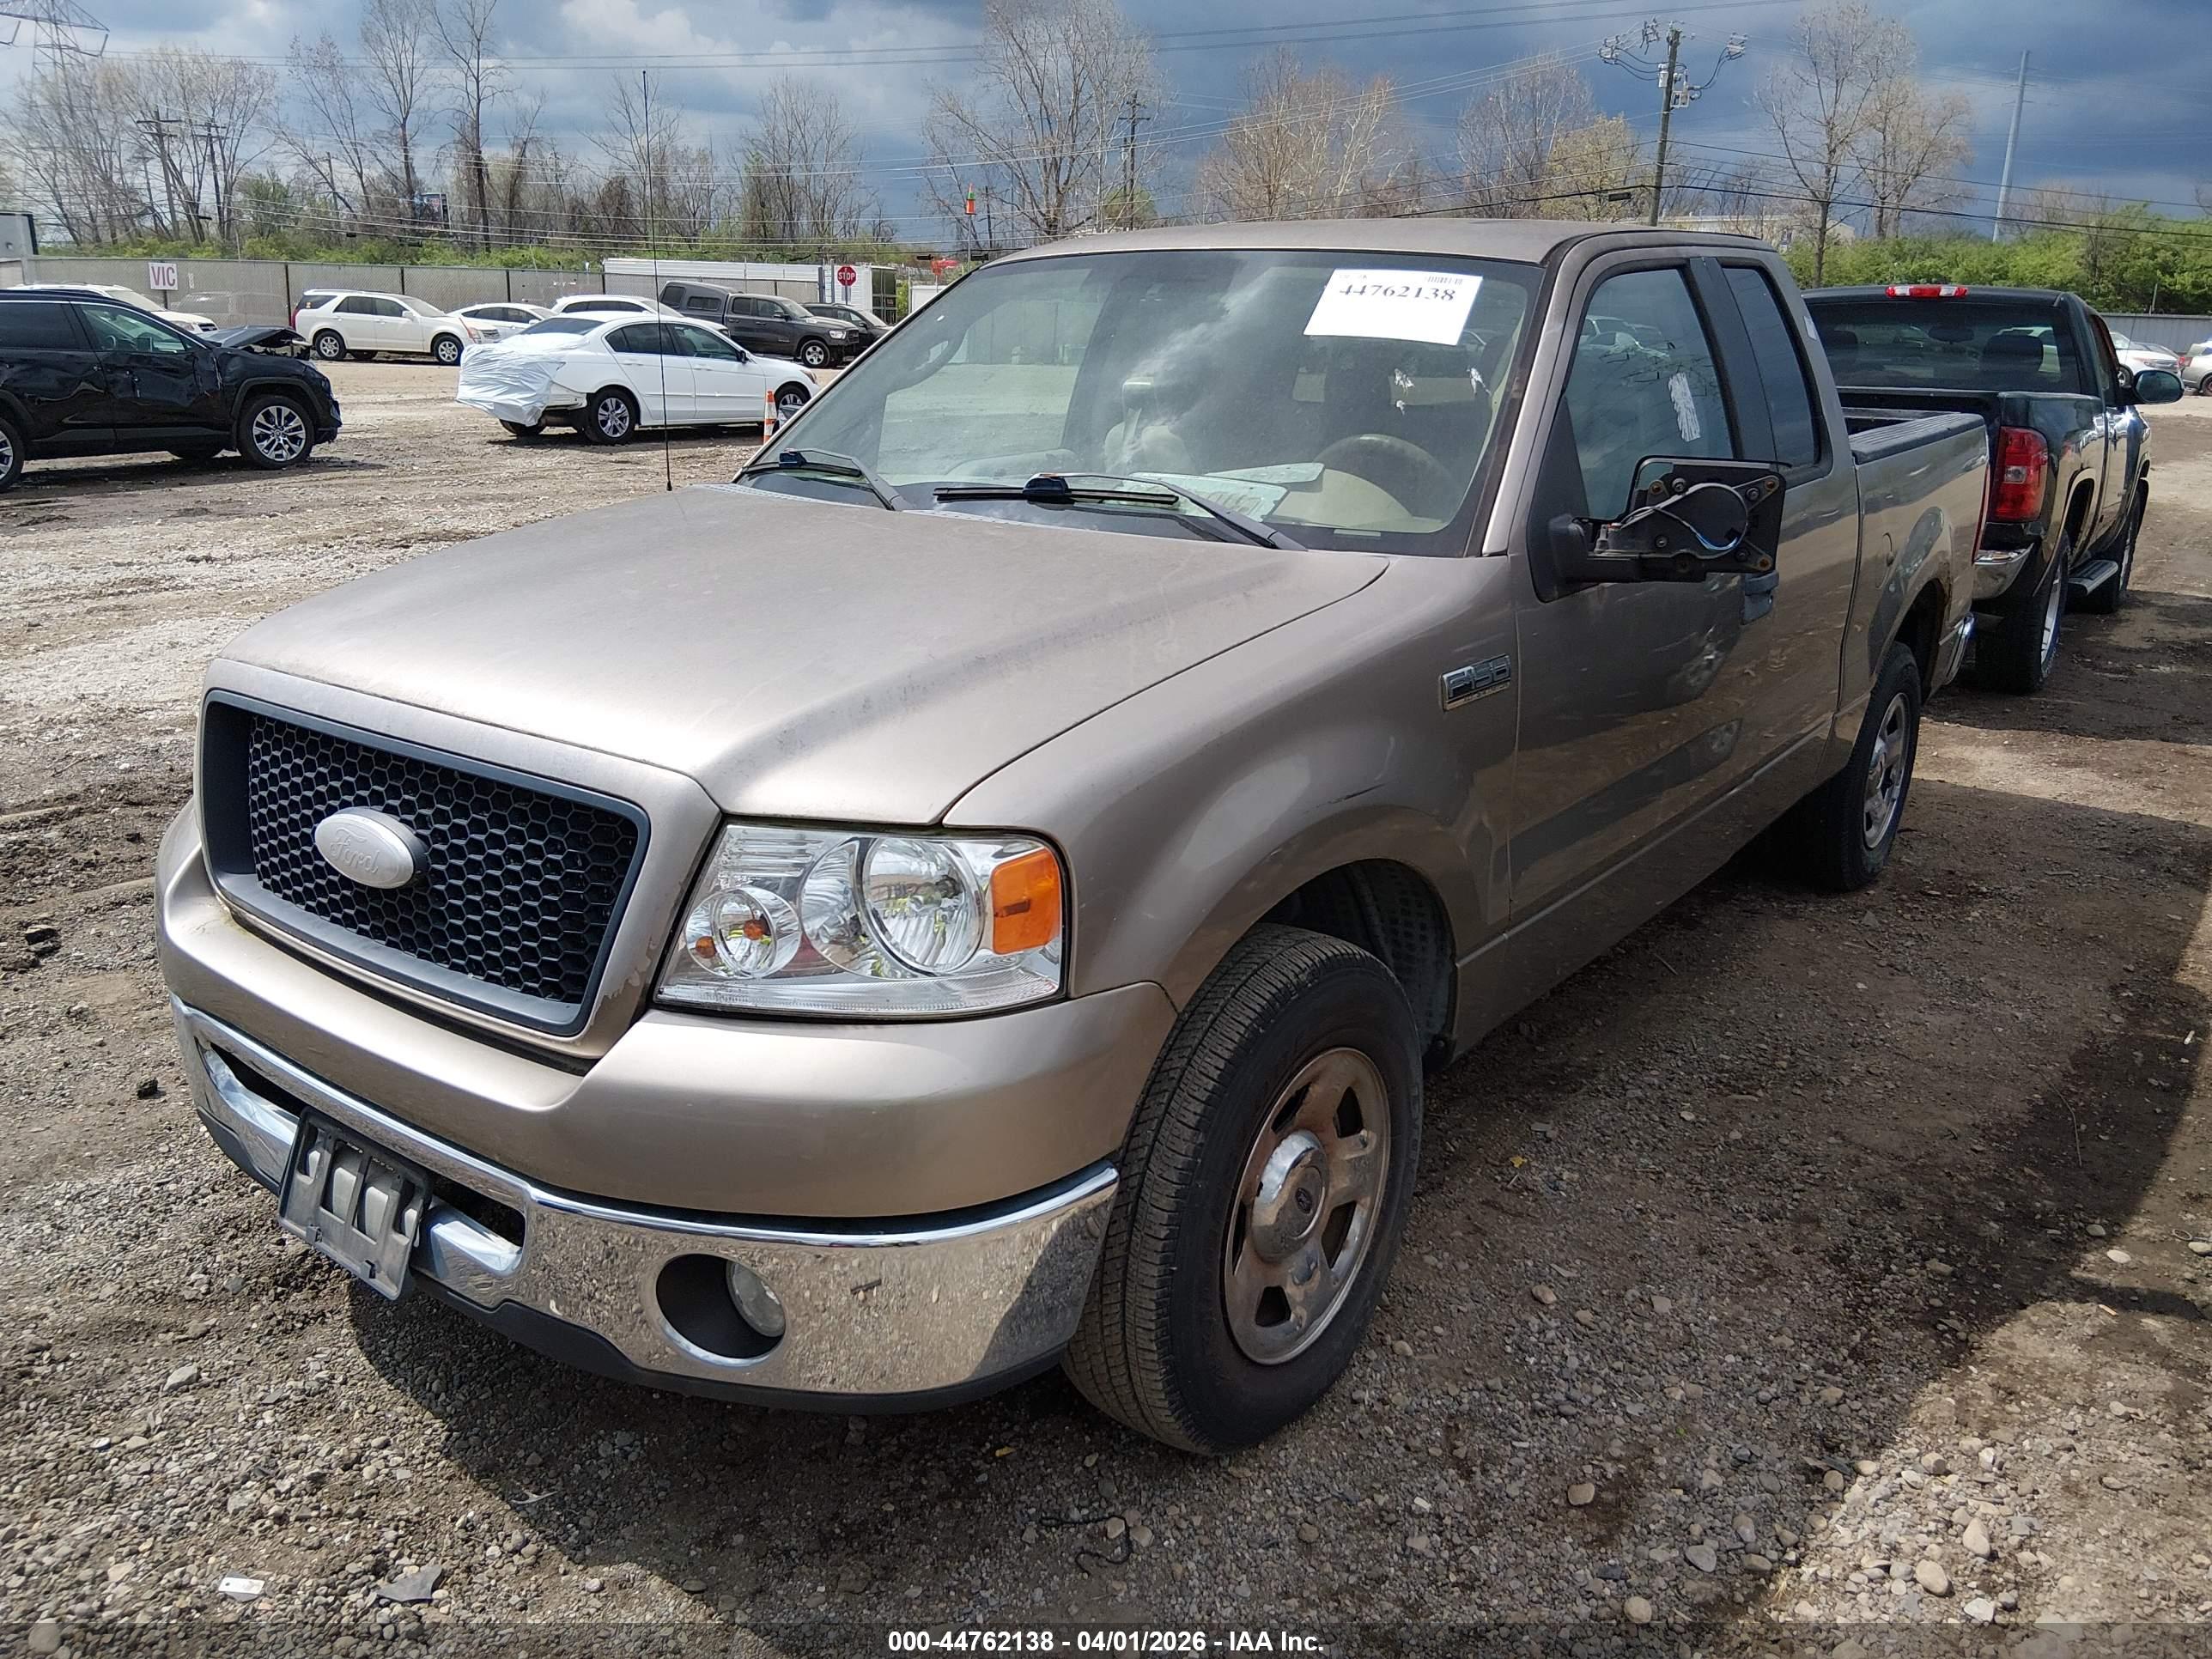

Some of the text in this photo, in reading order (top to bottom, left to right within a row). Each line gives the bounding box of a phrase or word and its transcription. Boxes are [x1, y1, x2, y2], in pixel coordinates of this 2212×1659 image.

[151, 266, 176, 287] VIC
[838, 271, 855, 281] STOP
[1339, 283, 1456, 301] 44762138
[329, 827, 380, 873] Ford
